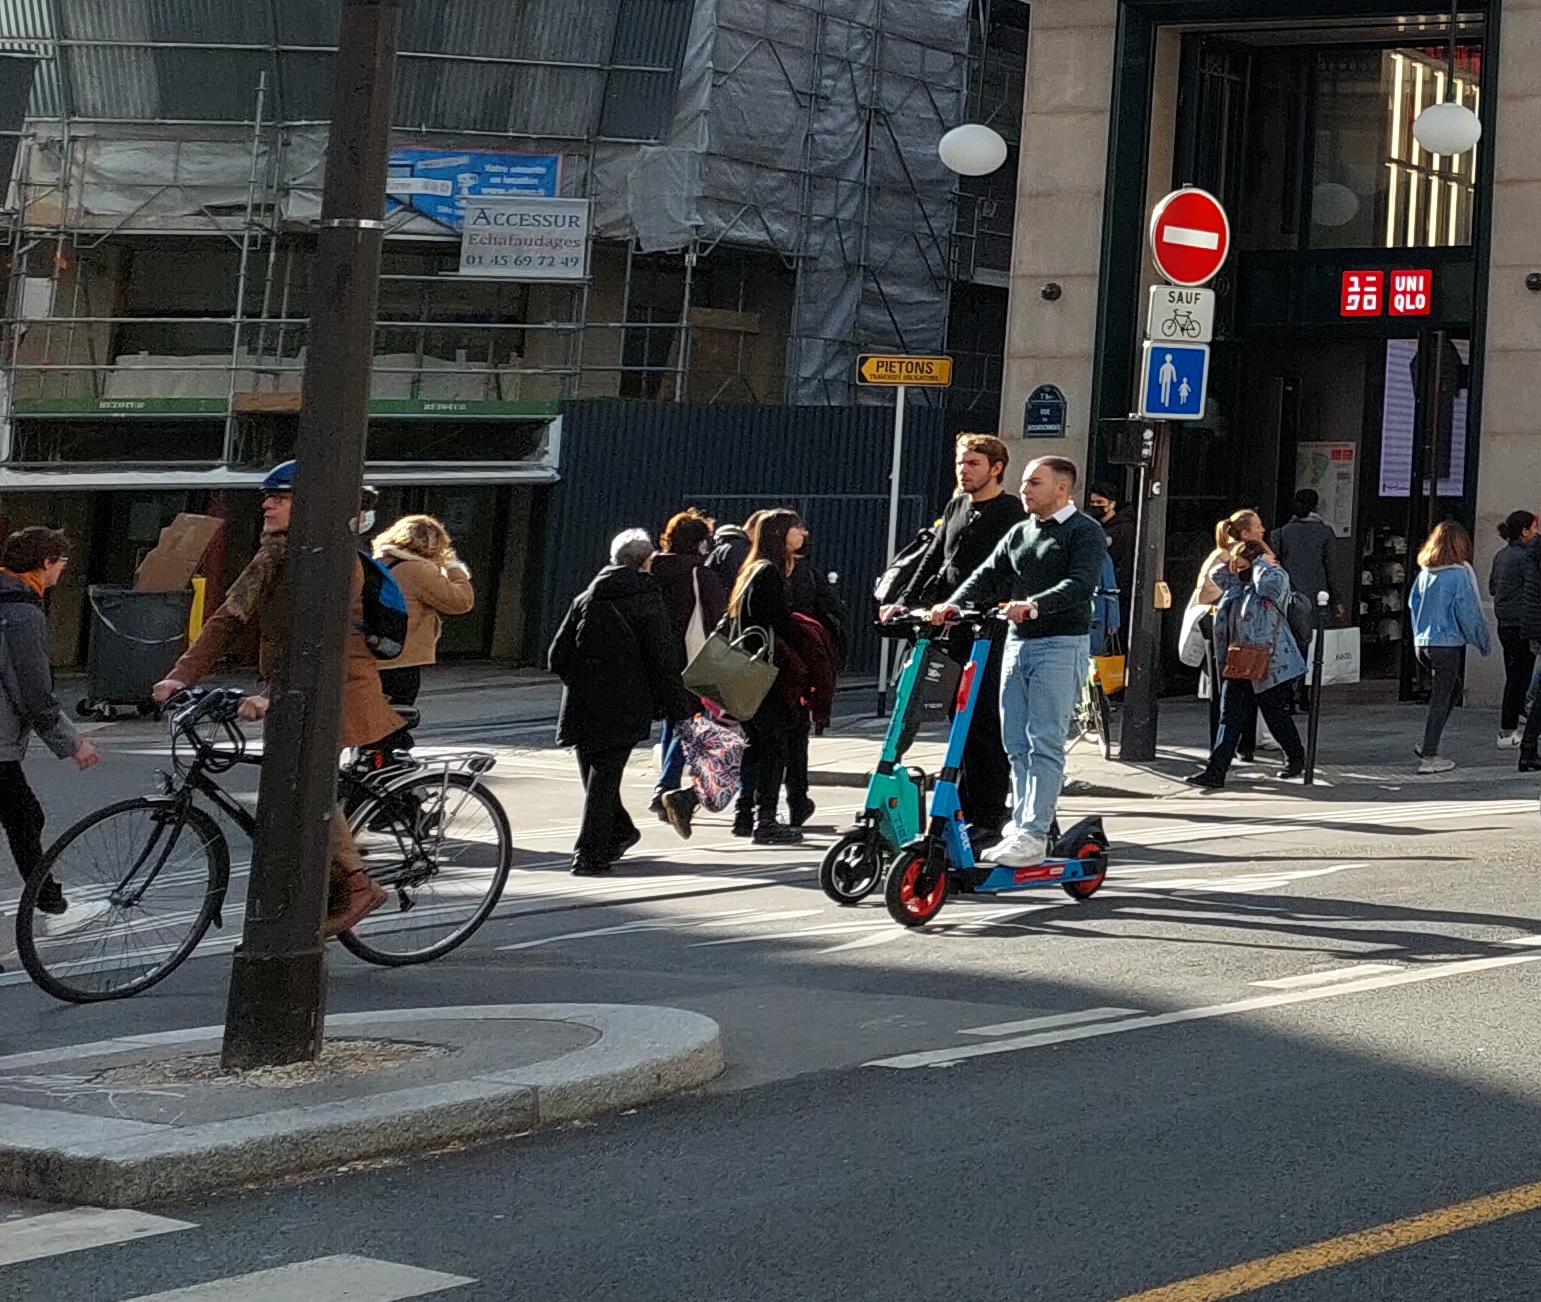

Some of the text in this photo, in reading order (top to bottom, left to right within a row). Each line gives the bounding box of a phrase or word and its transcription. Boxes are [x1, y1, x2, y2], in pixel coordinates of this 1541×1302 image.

[468, 233, 581, 249] Echafaudages
[466, 255, 482, 265] 01
[490, 255, 508, 266] 45
[513, 255, 532, 267] 69
[538, 256, 555, 267] 72
[1395, 275, 1424, 291] UNI
[1168, 291, 1201, 305] SAUF
[1394, 293, 1426, 312] QLO
[876, 360, 934, 374] PIETONS
